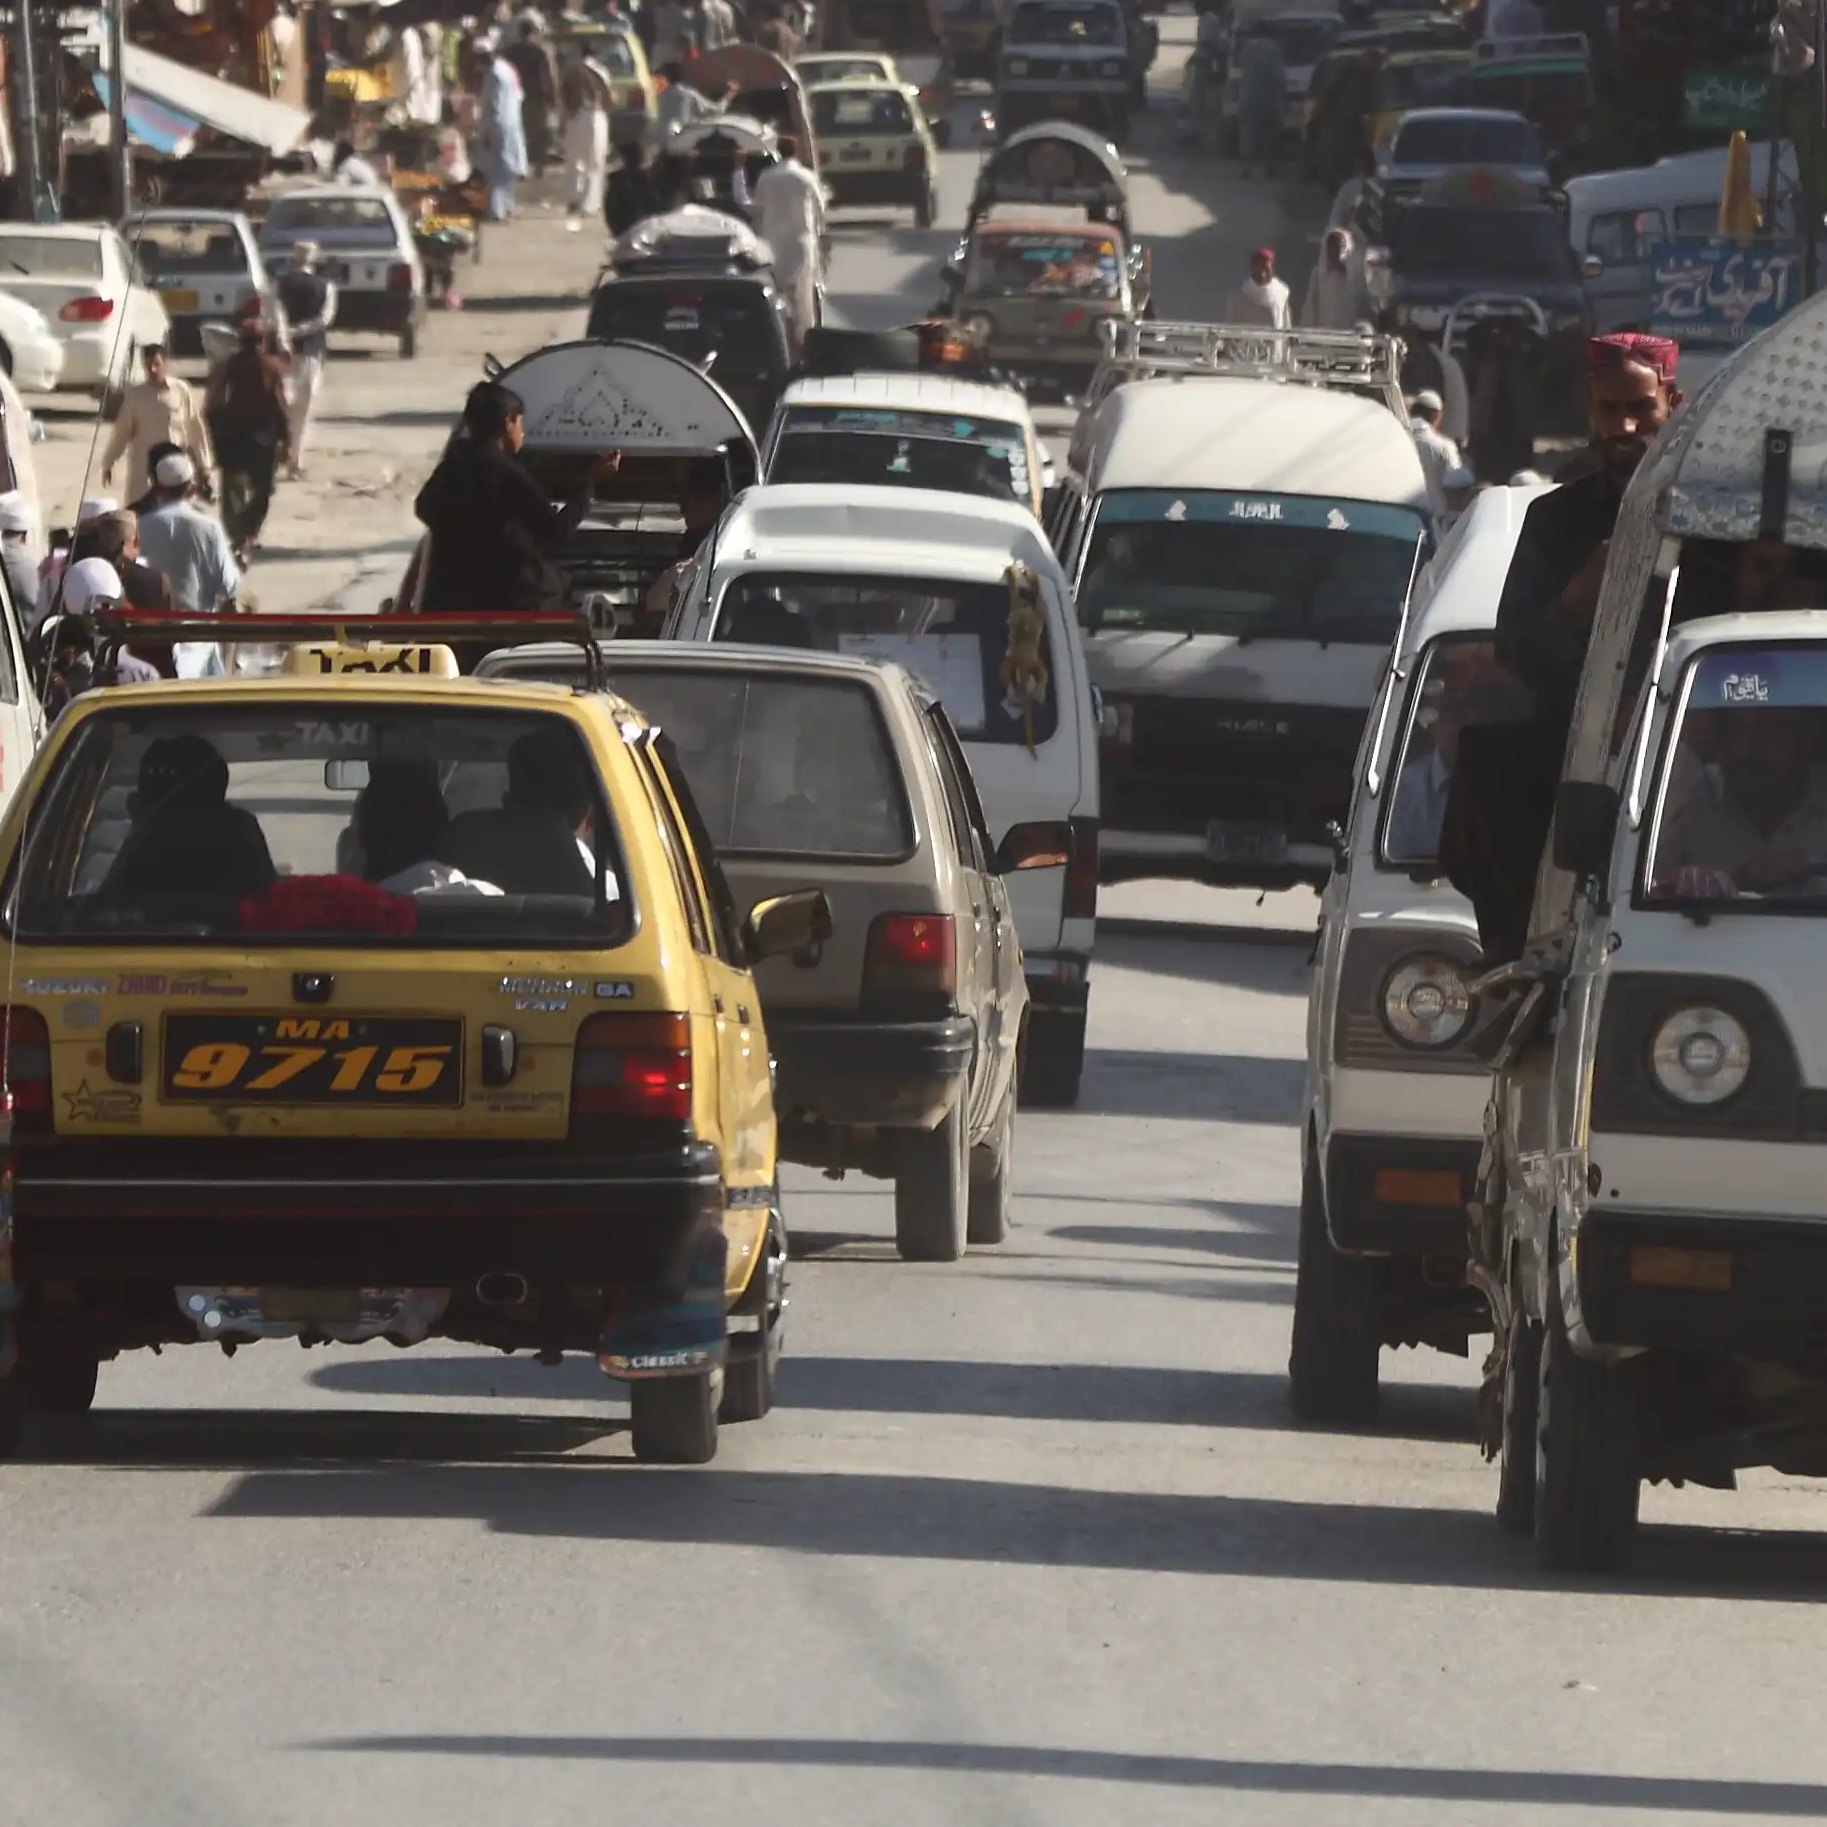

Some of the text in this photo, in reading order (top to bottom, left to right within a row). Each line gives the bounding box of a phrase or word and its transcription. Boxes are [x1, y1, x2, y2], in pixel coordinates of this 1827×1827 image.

[309, 647, 432, 674] TAXI
[293, 719, 371, 747] TAXI
[19, 976, 109, 996] SUZUKI
[276, 1019, 351, 1041] MA
[173, 1043, 454, 1094] 9715
